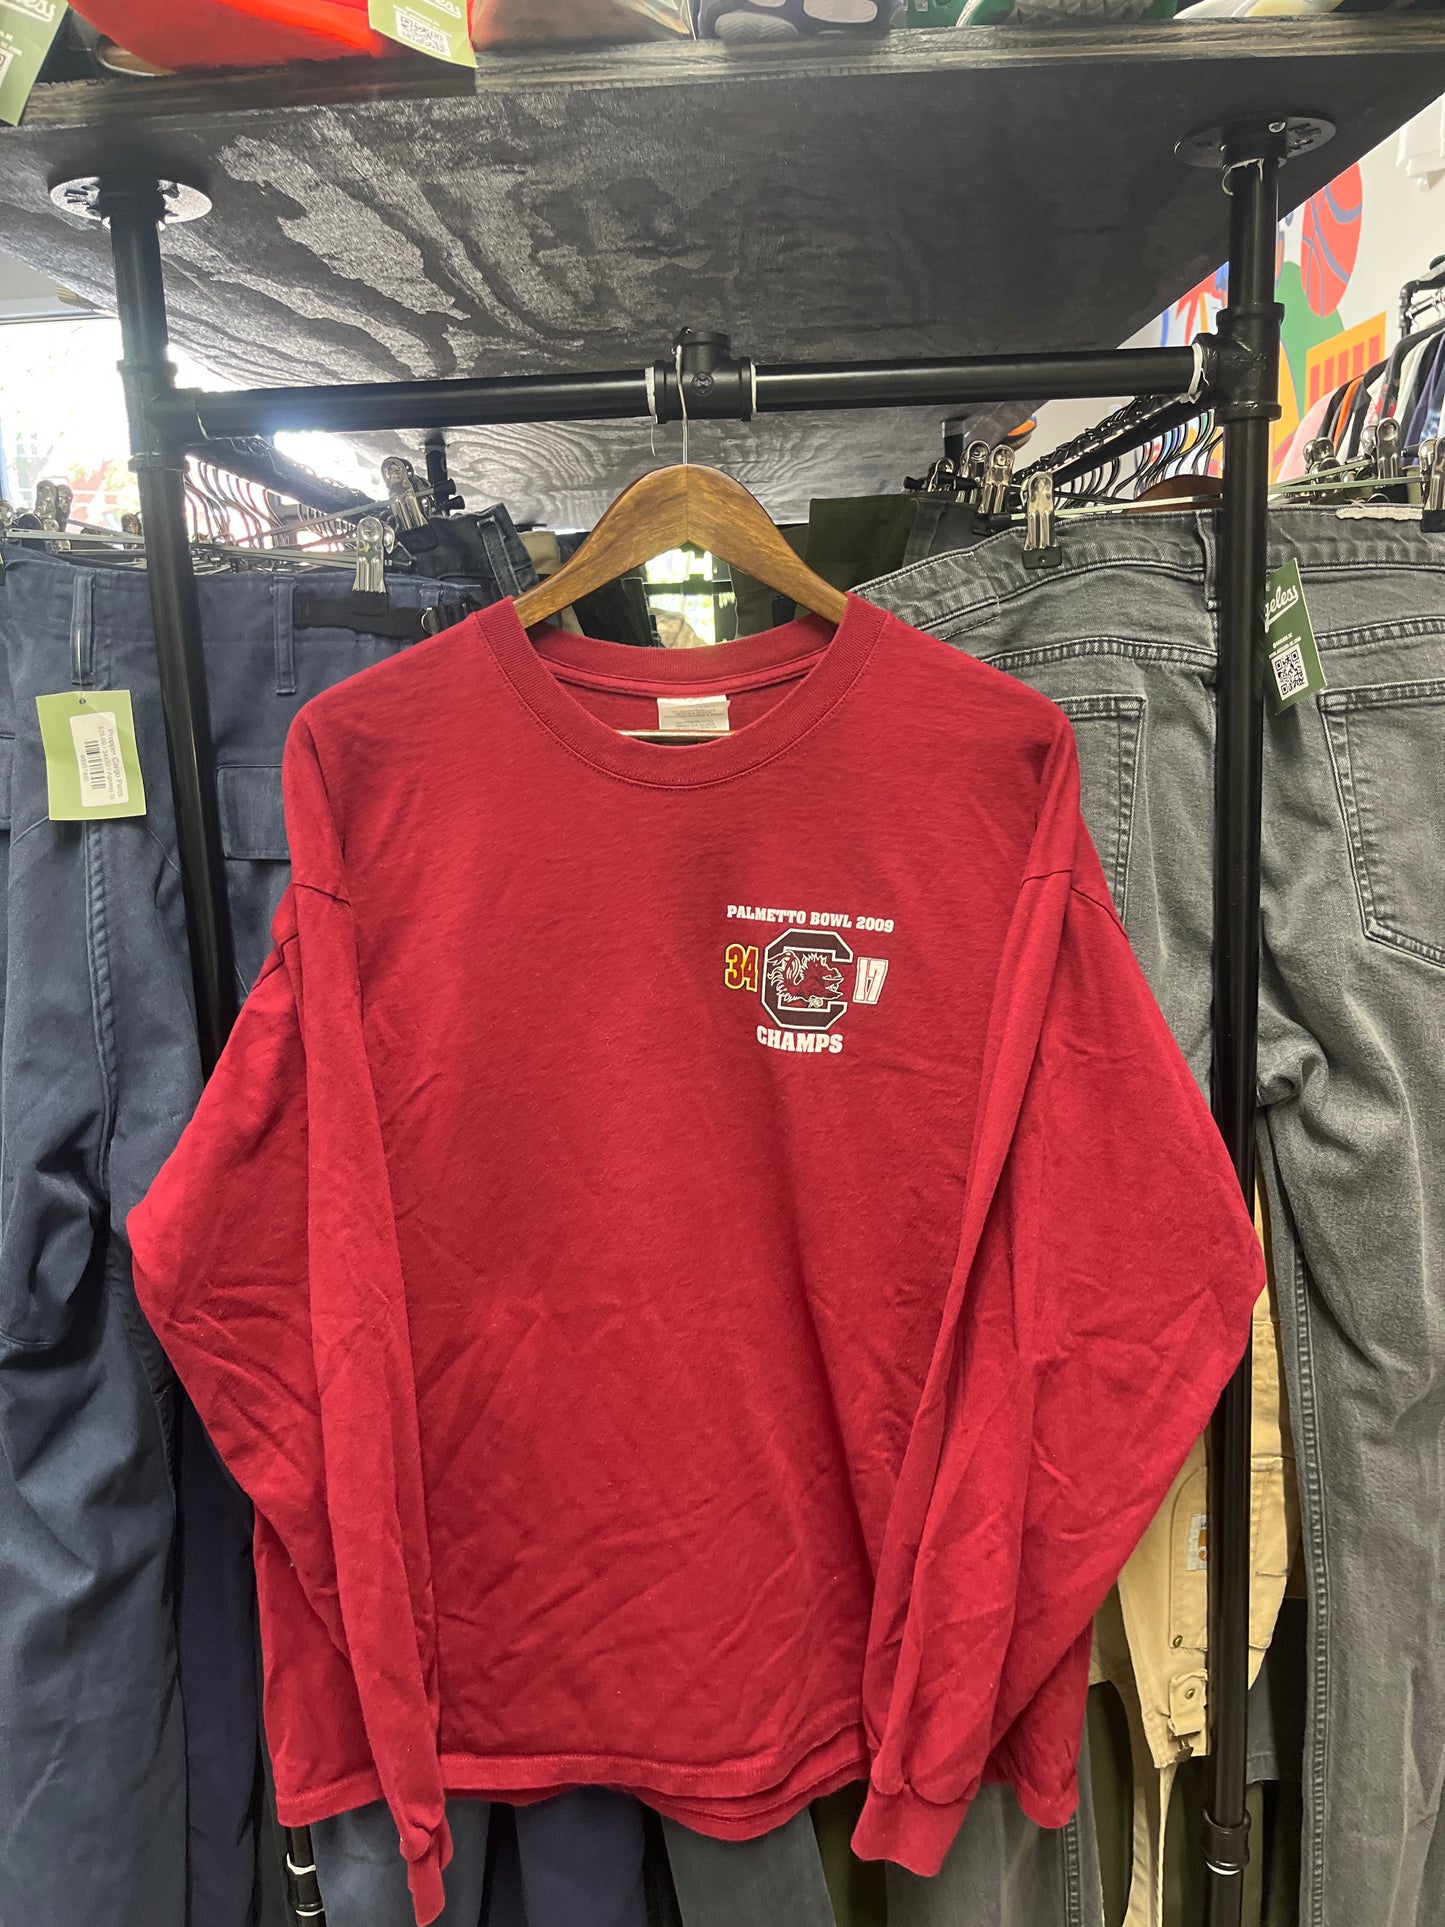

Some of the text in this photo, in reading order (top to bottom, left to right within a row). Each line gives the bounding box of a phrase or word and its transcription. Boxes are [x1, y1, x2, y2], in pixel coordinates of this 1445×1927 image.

[1265, 585, 1299, 634] geless
[112, 757, 121, 778] Cargo
[727, 905, 894, 933] PALMETTO BOWL 2009
[724, 943, 759, 992] 34
[853, 956, 889, 1004] 17
[756, 1025, 844, 1053] CHAMPS
